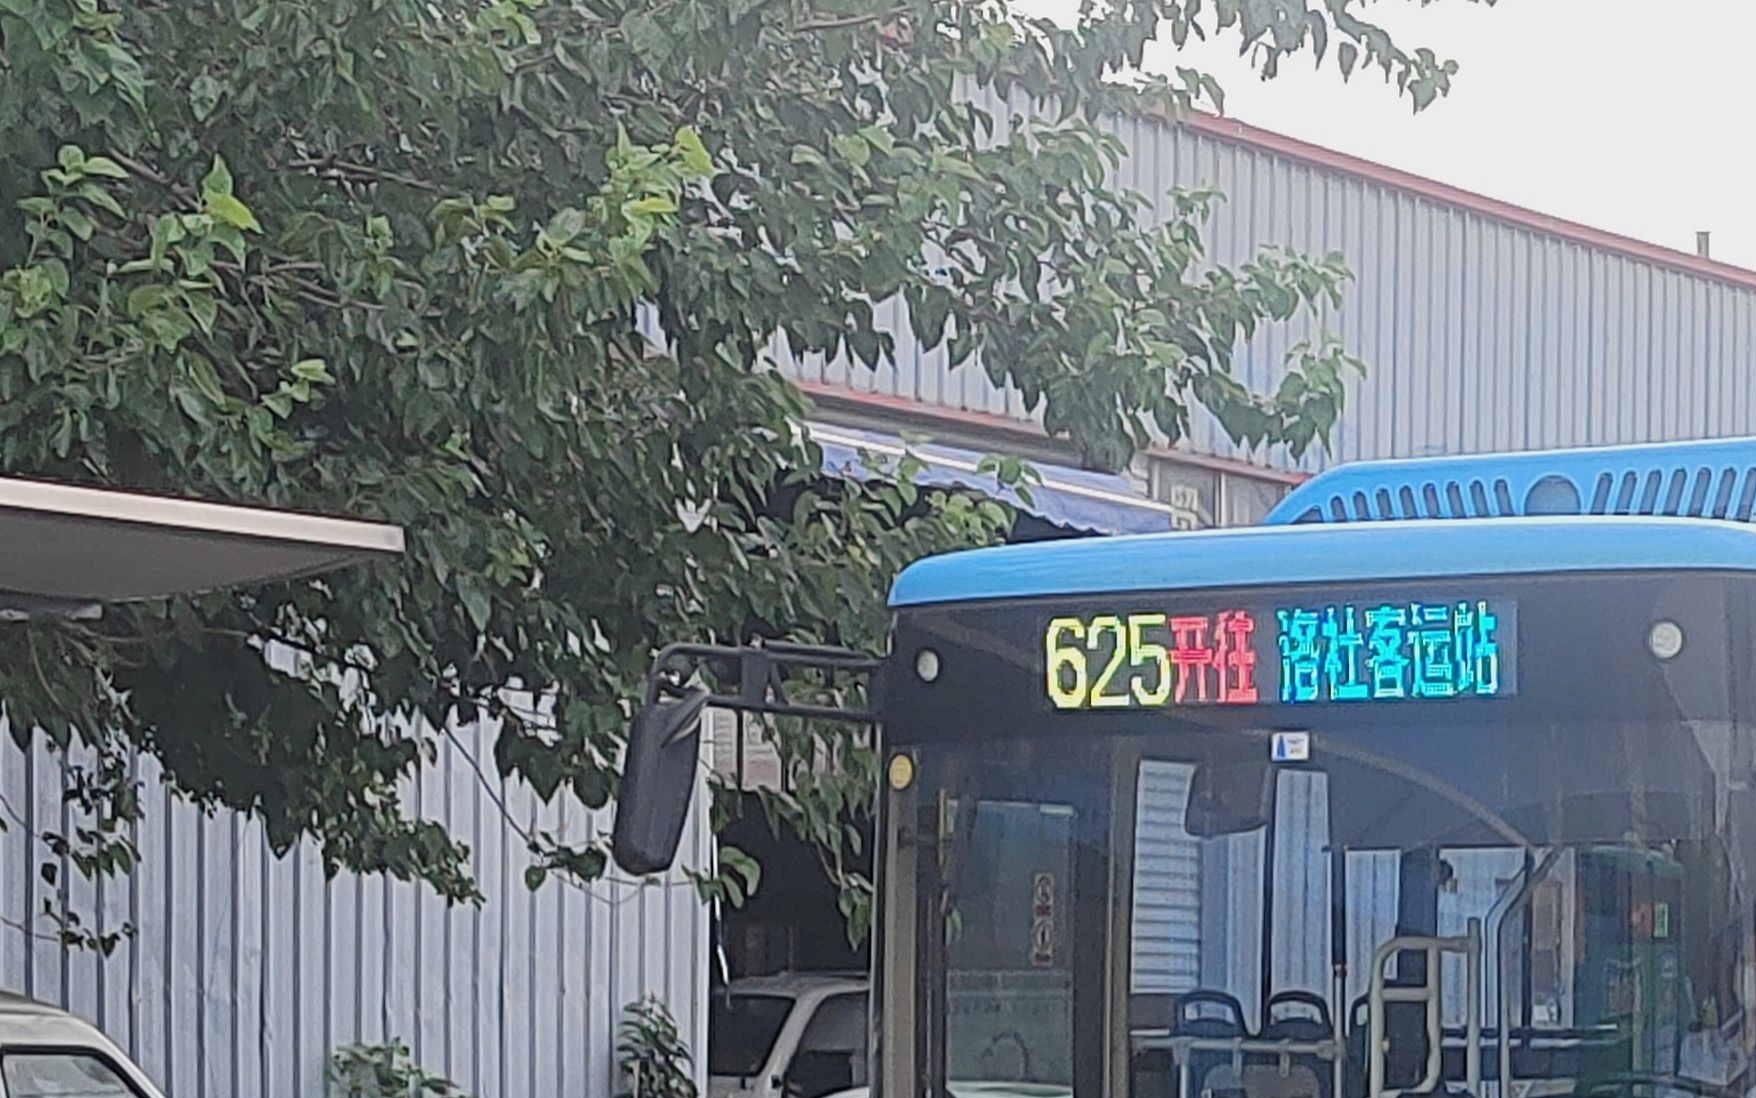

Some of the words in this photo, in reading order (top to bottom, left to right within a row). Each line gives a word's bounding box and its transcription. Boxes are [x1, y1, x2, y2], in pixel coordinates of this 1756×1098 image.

[1046, 613, 1170, 707] 625
[1168, 610, 1258, 703] 开往
[1277, 601, 1498, 701] 洛社客运站
